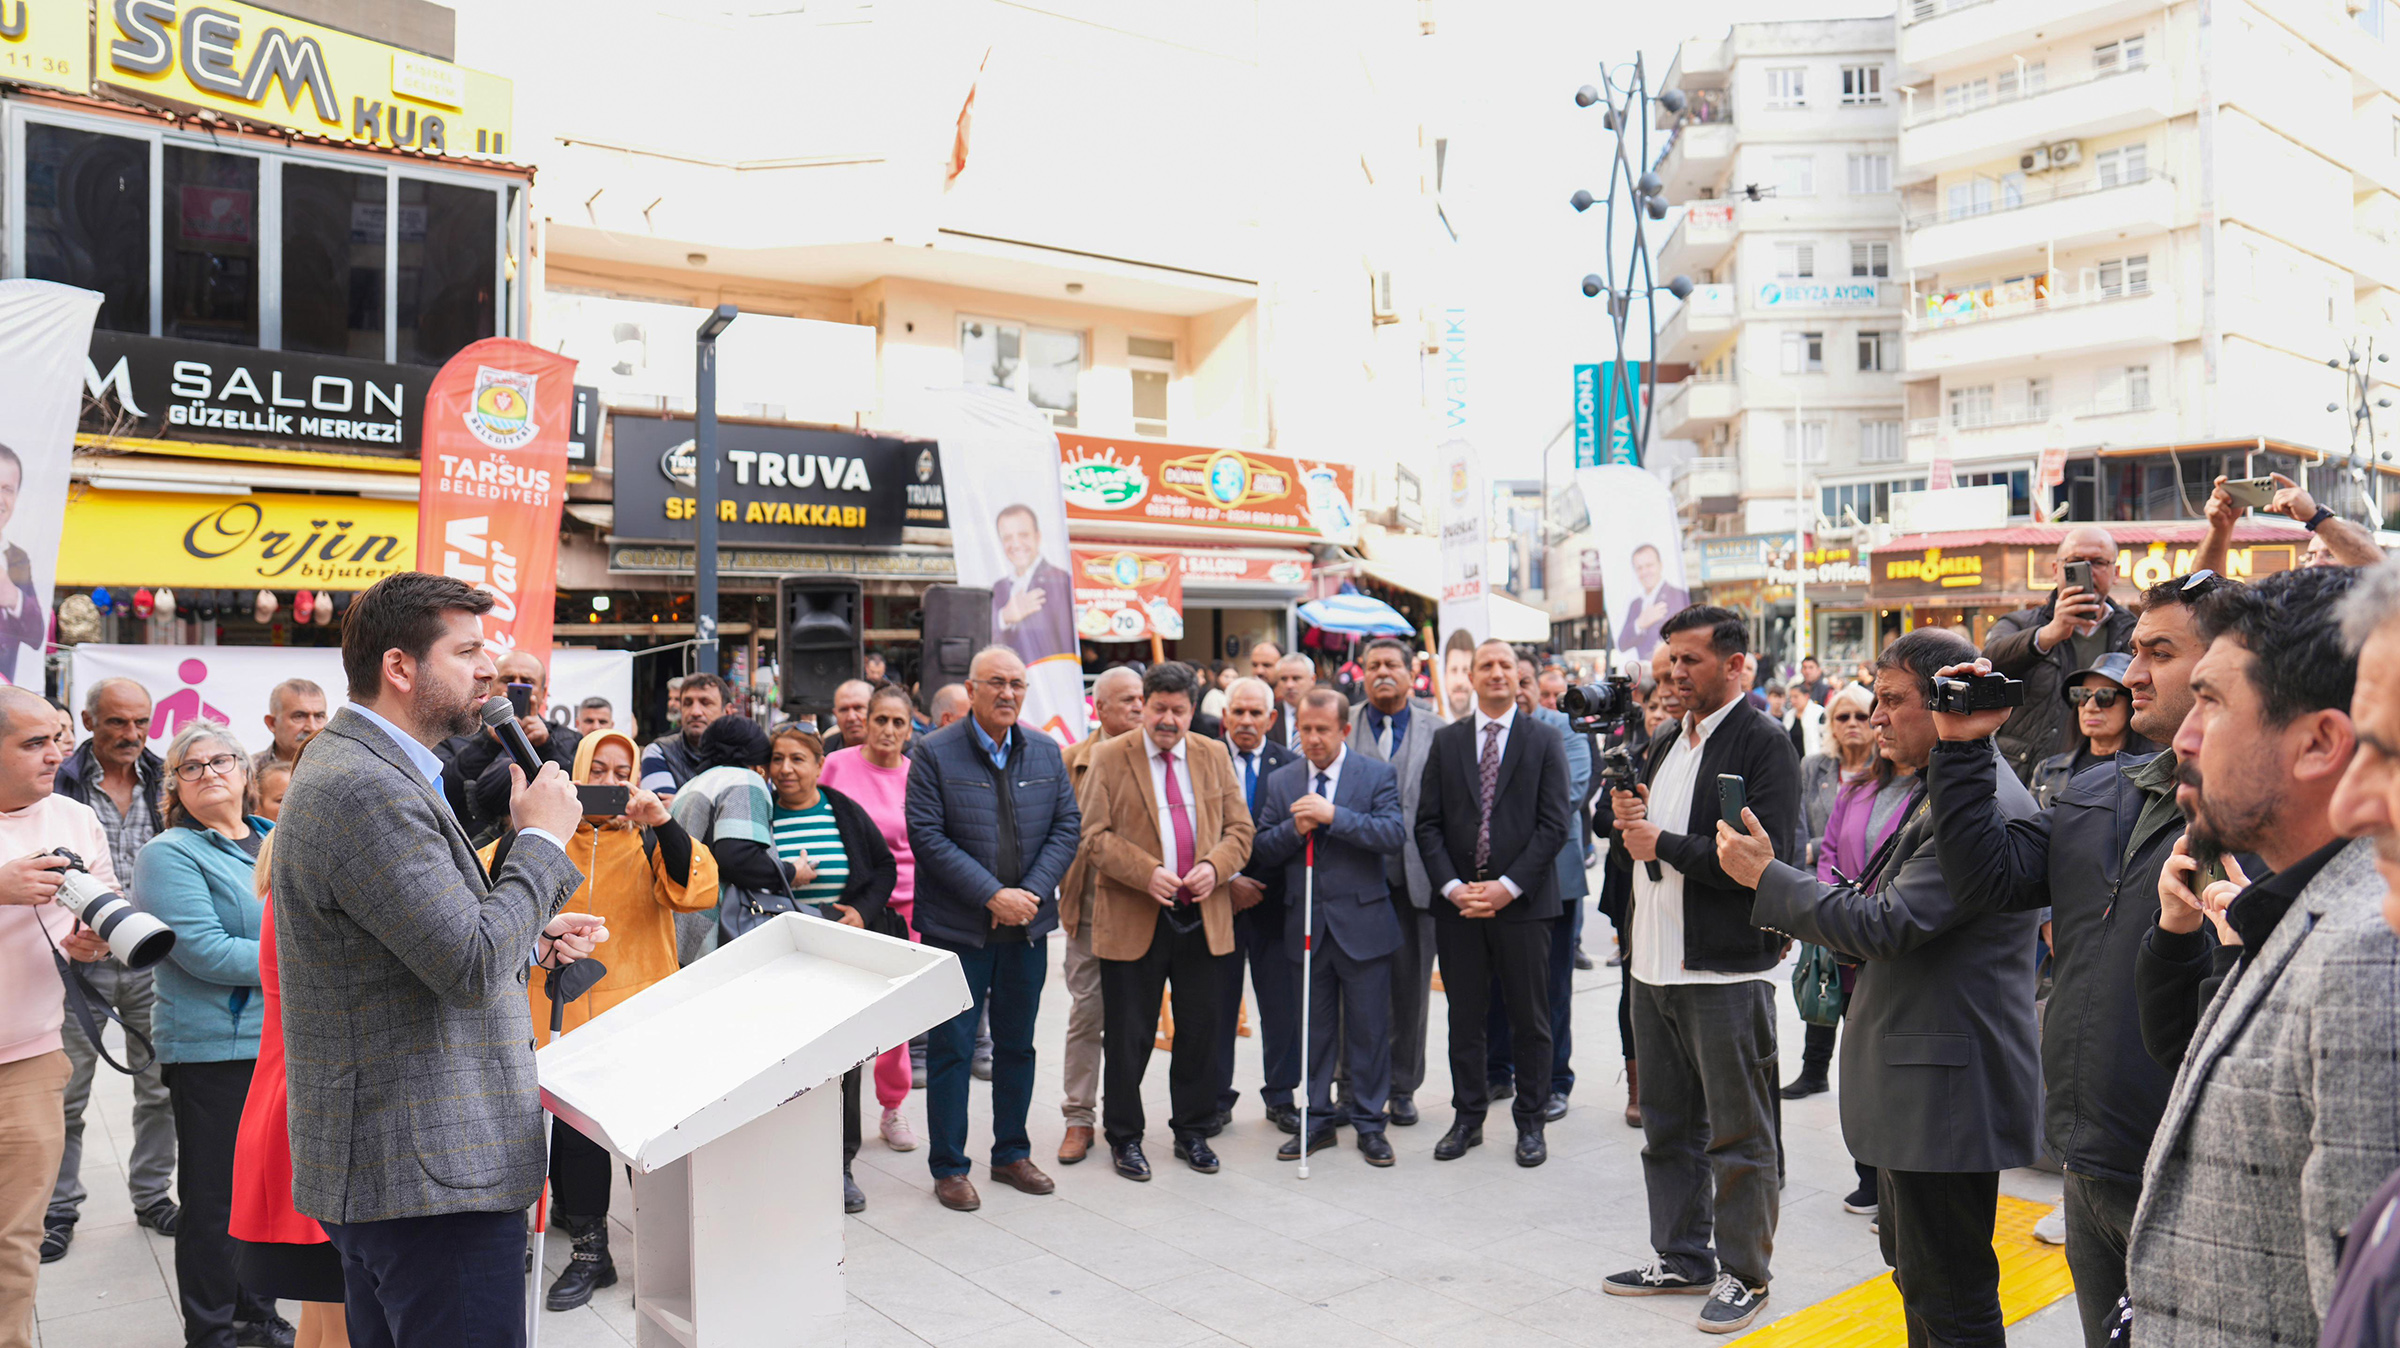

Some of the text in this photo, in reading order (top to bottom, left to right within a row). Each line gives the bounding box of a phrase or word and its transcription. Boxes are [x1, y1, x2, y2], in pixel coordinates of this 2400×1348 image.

[112, 0, 340, 122] SEM
[1785, 284, 1876, 300] BEYZA AYDIN
[171, 360, 404, 418] SALON
[168, 399, 403, 443] GÜZELLİK MERKEZİ
[1576, 368, 1596, 468] BELLONA
[438, 454, 551, 492] TARSUS
[727, 449, 872, 492] TRUVA
[440, 478, 549, 507] BELEDİYESİ
[906, 484, 944, 506] TRUVA
[745, 501, 867, 529] AYAKKABI
[183, 501, 407, 577] Orjin
